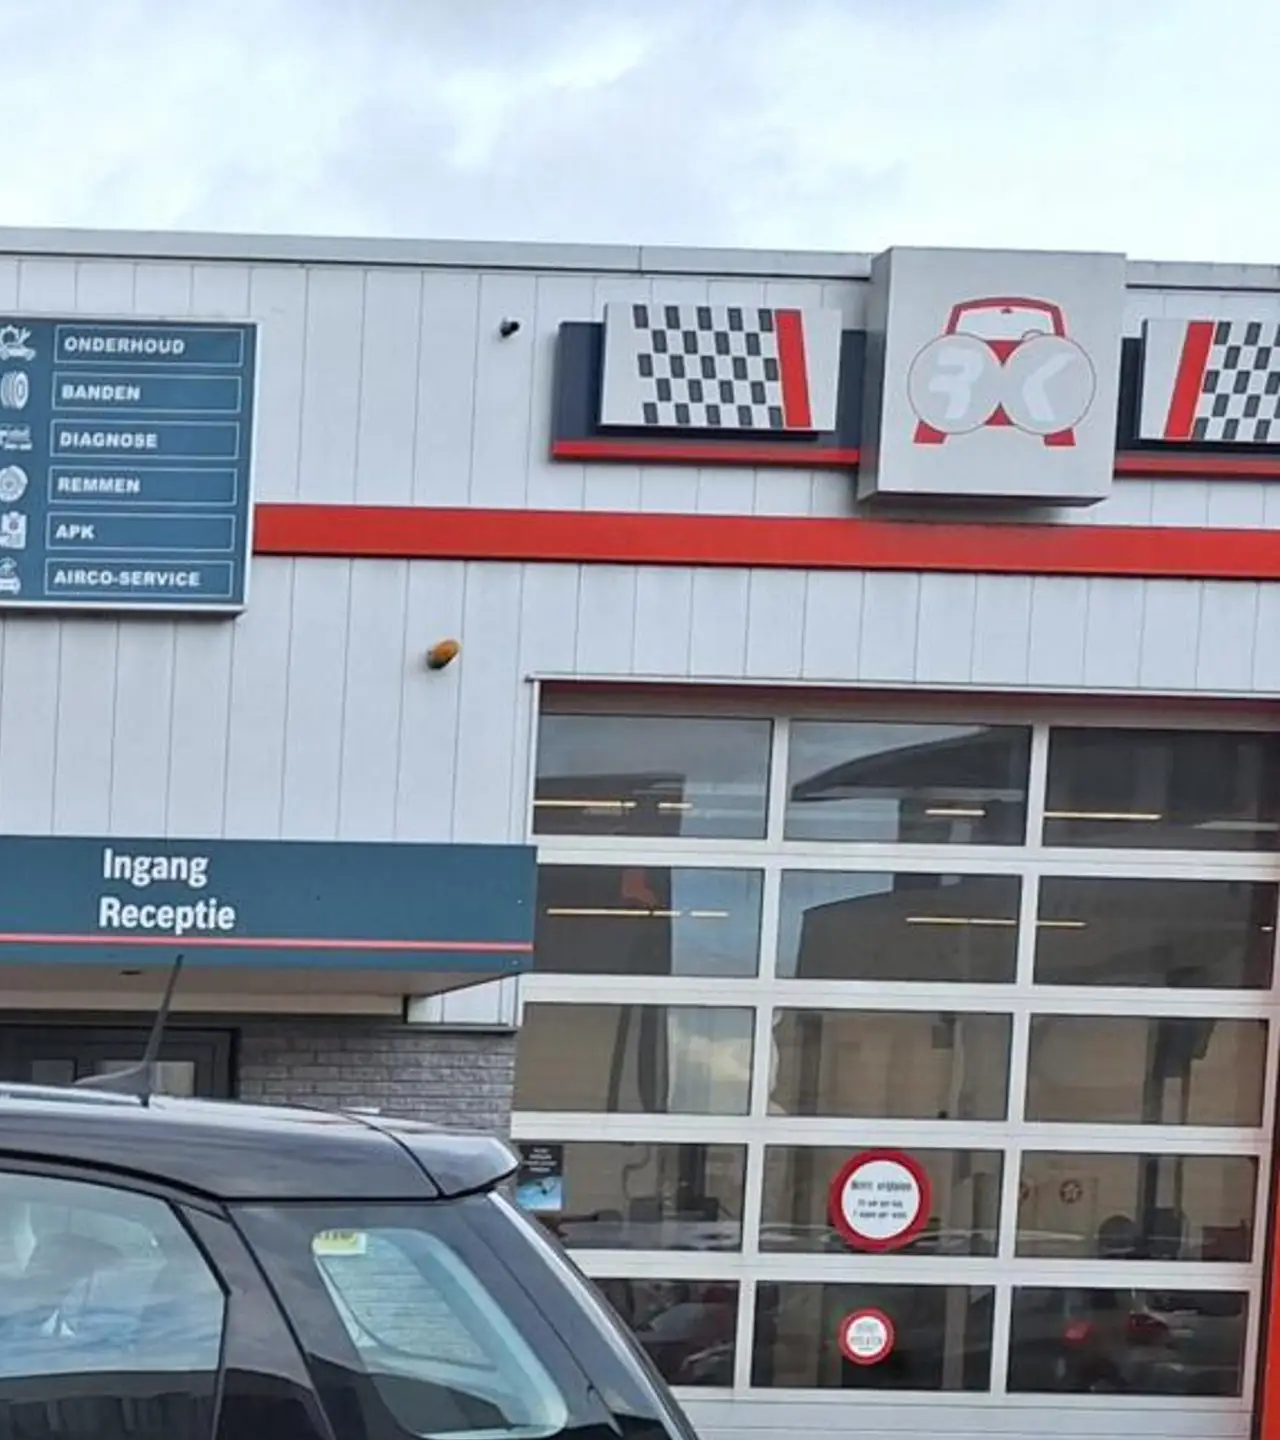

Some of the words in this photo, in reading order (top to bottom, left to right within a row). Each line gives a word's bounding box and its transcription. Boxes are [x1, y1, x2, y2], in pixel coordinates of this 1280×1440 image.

[64, 336, 185, 355] ONDERHOUD
[61, 383, 141, 401] BANDEN
[59, 431, 158, 449] DIAGNOSE
[57, 476, 141, 493] REMMEN
[55, 525, 95, 539] APK
[53, 570, 201, 587] AIRCO-SERVICE
[103, 848, 209, 888] Ingang
[99, 896, 236, 935] Receptie
